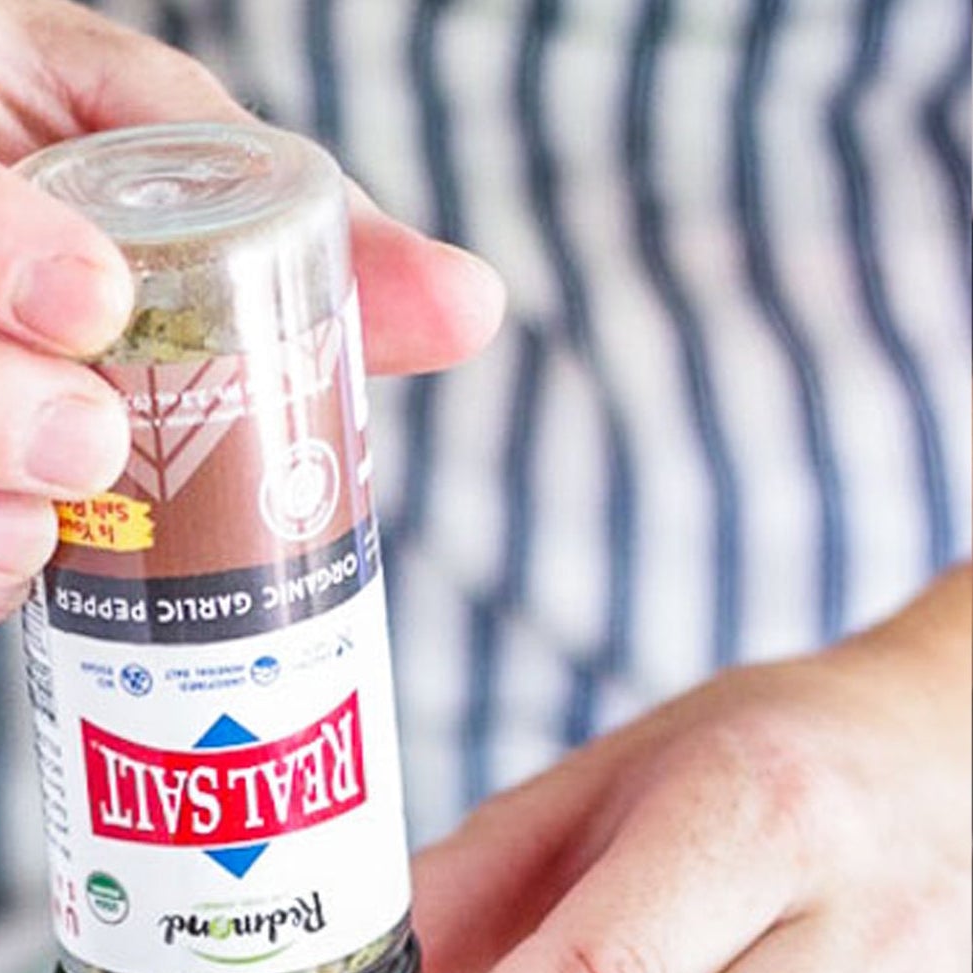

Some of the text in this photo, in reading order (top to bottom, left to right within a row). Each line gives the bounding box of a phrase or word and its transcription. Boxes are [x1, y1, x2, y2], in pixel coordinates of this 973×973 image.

[55, 554, 359, 622] ORGANIC GARLIC PEPPER
[158, 890, 326, 945] Redmond
